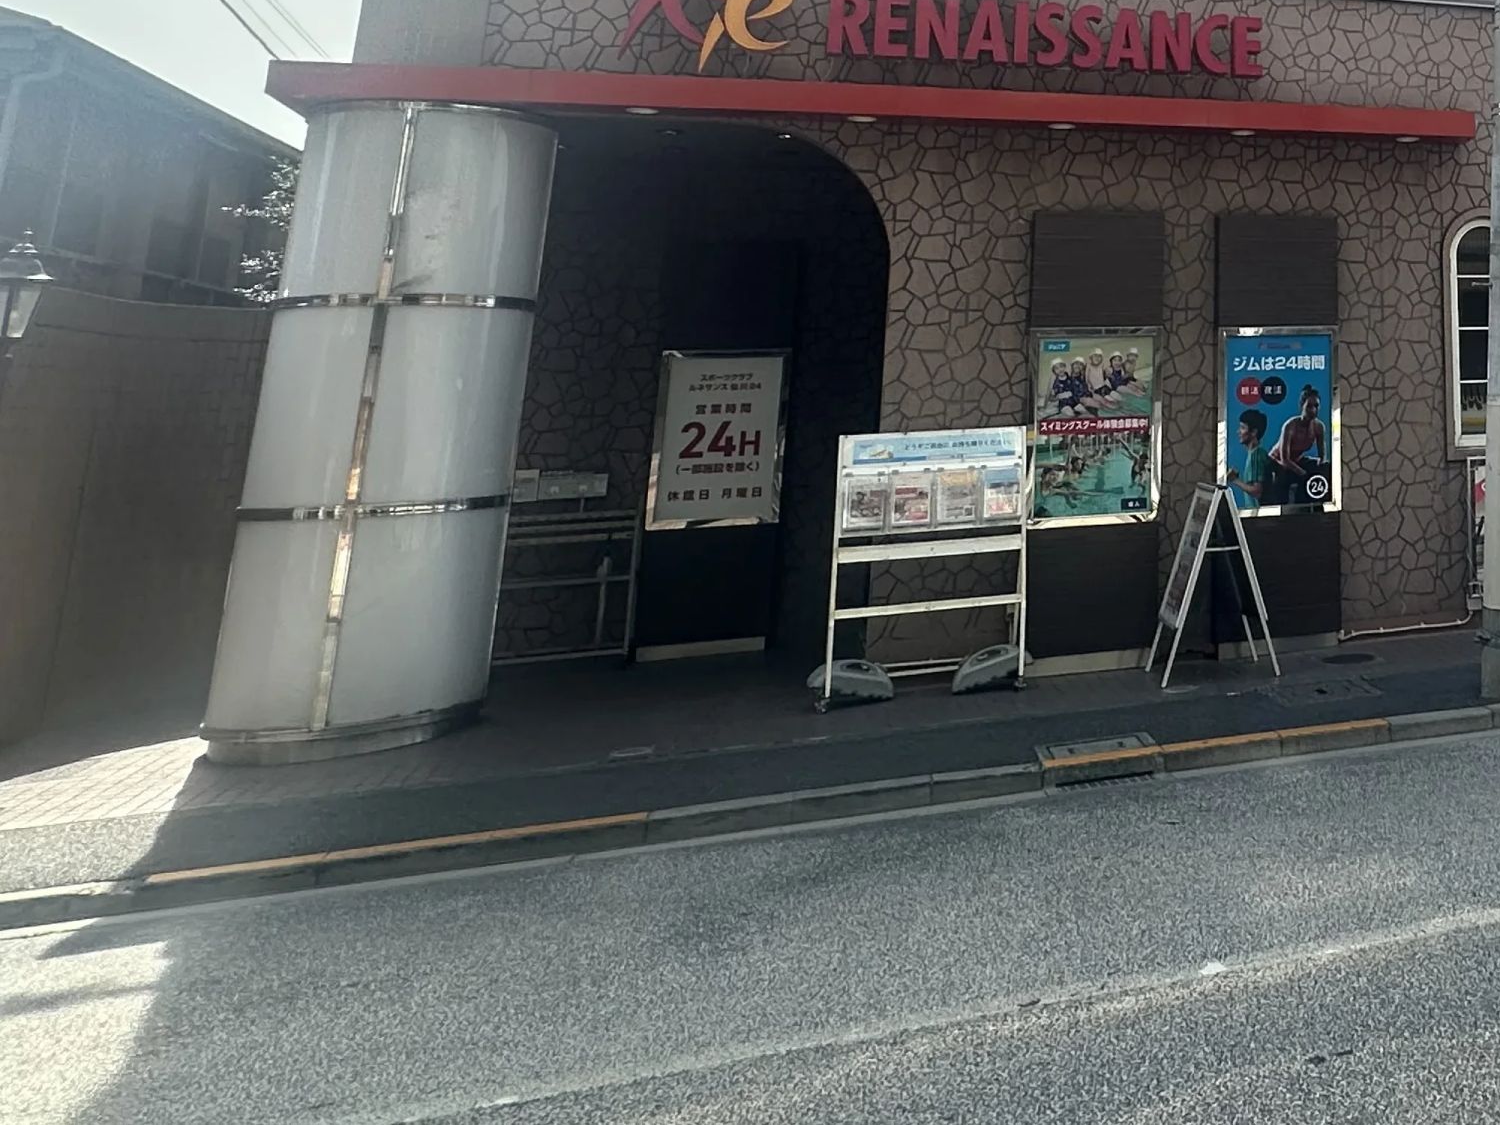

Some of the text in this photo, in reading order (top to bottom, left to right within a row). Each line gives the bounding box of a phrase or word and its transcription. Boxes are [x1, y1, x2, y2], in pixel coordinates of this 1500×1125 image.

[1232, 354, 1325, 372] ジムは24時間
[695, 403, 751, 415] 営業時間
[679, 420, 761, 459] 24H
[667, 486, 762, 502] 休館日 月曜日
[1311, 481, 1324, 493] 24
